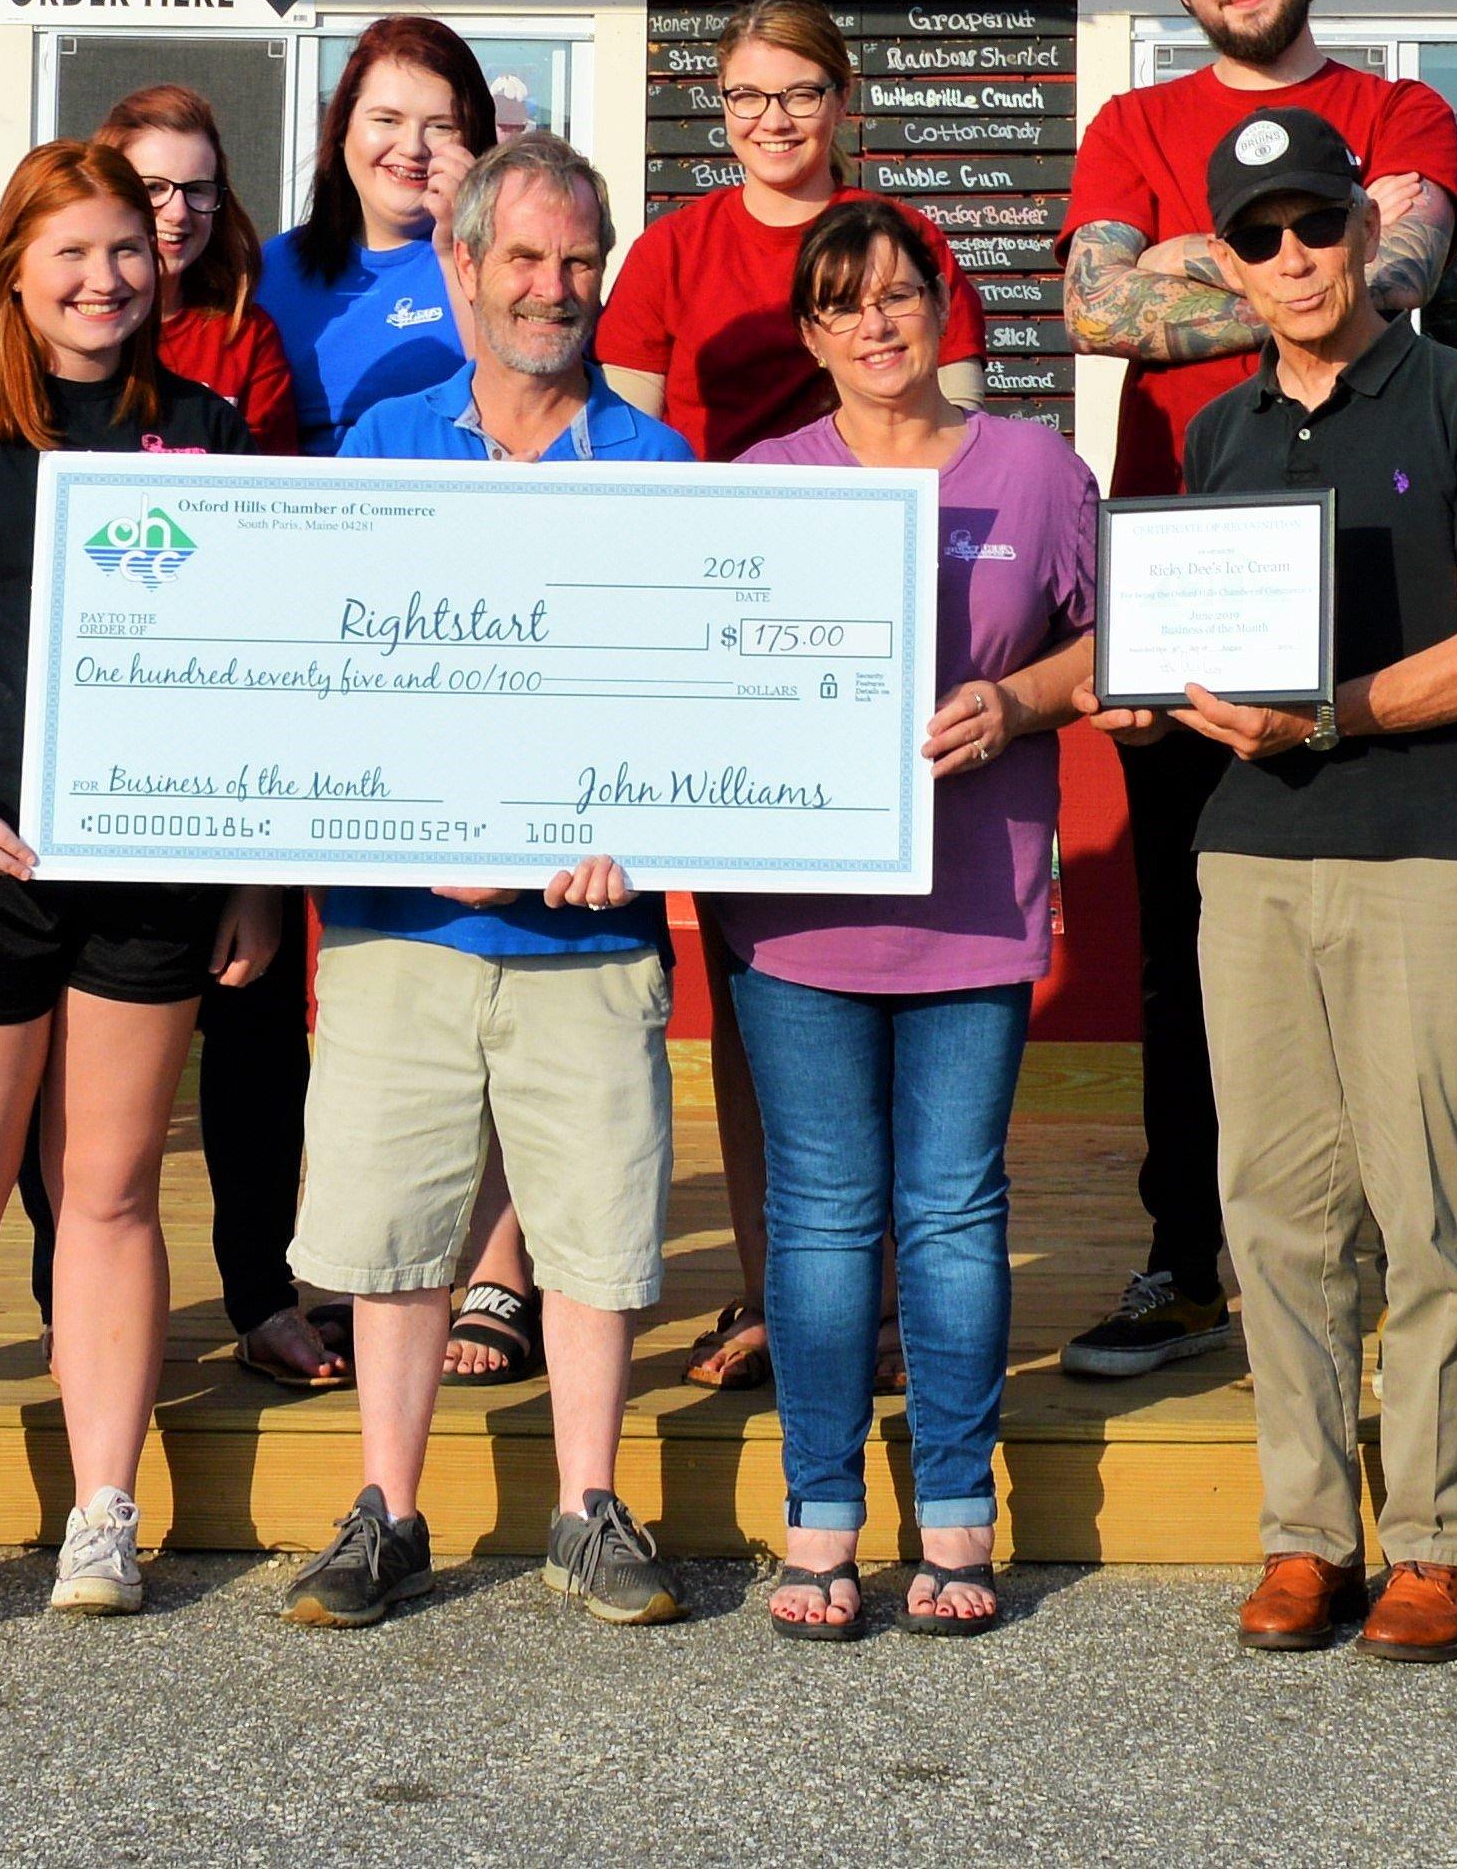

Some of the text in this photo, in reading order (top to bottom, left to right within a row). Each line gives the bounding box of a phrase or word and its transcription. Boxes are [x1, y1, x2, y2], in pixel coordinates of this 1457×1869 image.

[649, 14, 701, 37] Honey
[909, 6, 1037, 33] Grapenut
[980, 46, 1059, 68] Sherbet
[981, 82, 1045, 110] Crunch
[904, 122, 987, 144] Cotton
[1241, 132, 1281, 151] BRUINS
[879, 166, 1013, 189] Bubble Gum
[979, 284, 1042, 301] Tracks
[987, 372, 1055, 388] almond
[177, 498, 436, 518] Oxford Hills Chamber of Commerce
[236, 518, 375, 532] South Paris, Maine 04281
[1133, 524, 1203, 536] CERTIFICATE
[702, 555, 765, 581] 2018
[1149, 560, 1291, 579] Ricky Dee's Ice Cream
[735, 591, 771, 604] DATE
[80, 612, 157, 625] PAY TO THE
[341, 591, 549, 657] Rightstart
[1189, 610, 1214, 621] June
[78, 624, 148, 636] ORDER OF
[720, 624, 846, 654] $ 175.00
[1161, 622, 1269, 636] Business of the Month
[74, 652, 543, 700] One hundred seventy five and 00/100
[737, 684, 798, 698] DOLLARS
[72, 764, 392, 802] FOR Business of the Month
[576, 761, 833, 815] John Williams
[526, 822, 593, 845] 1000
